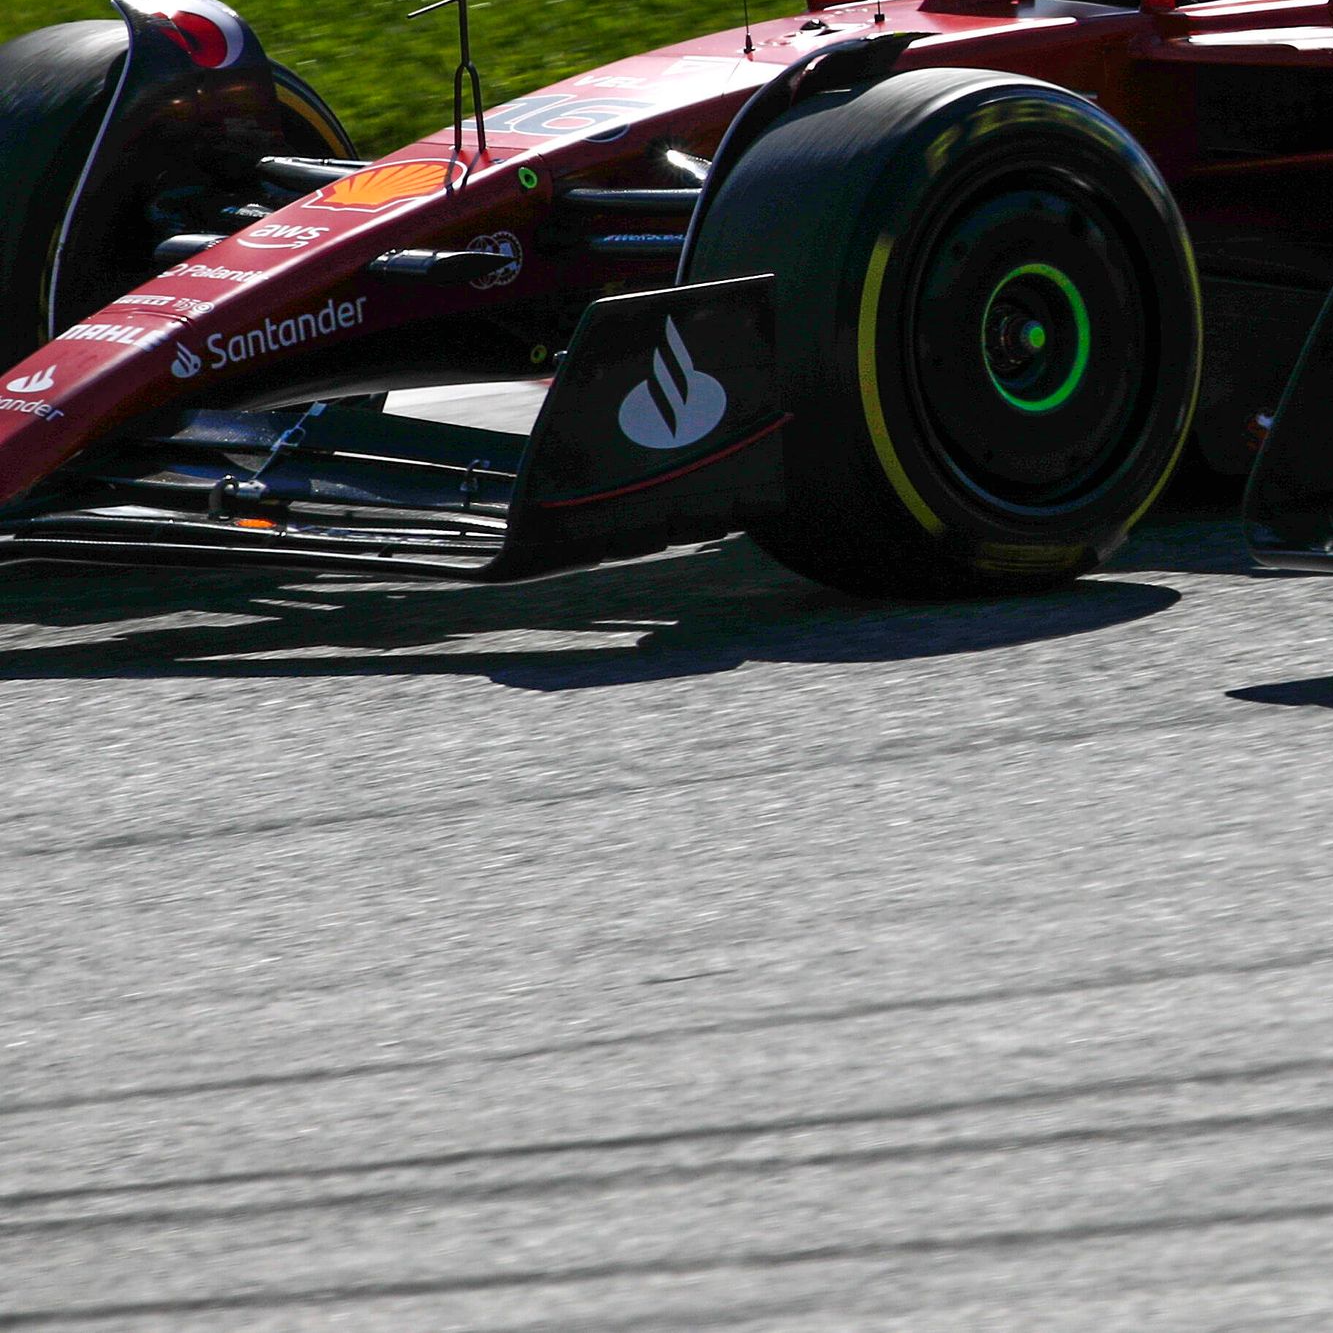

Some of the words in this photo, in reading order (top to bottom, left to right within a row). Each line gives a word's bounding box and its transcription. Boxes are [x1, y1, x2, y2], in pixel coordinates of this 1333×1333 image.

[447, 93, 658, 137] 16
[249, 223, 331, 240] aws
[55, 323, 172, 353] MAHLE
[206, 296, 368, 371] Santander
[0, 394, 65, 422] ander
